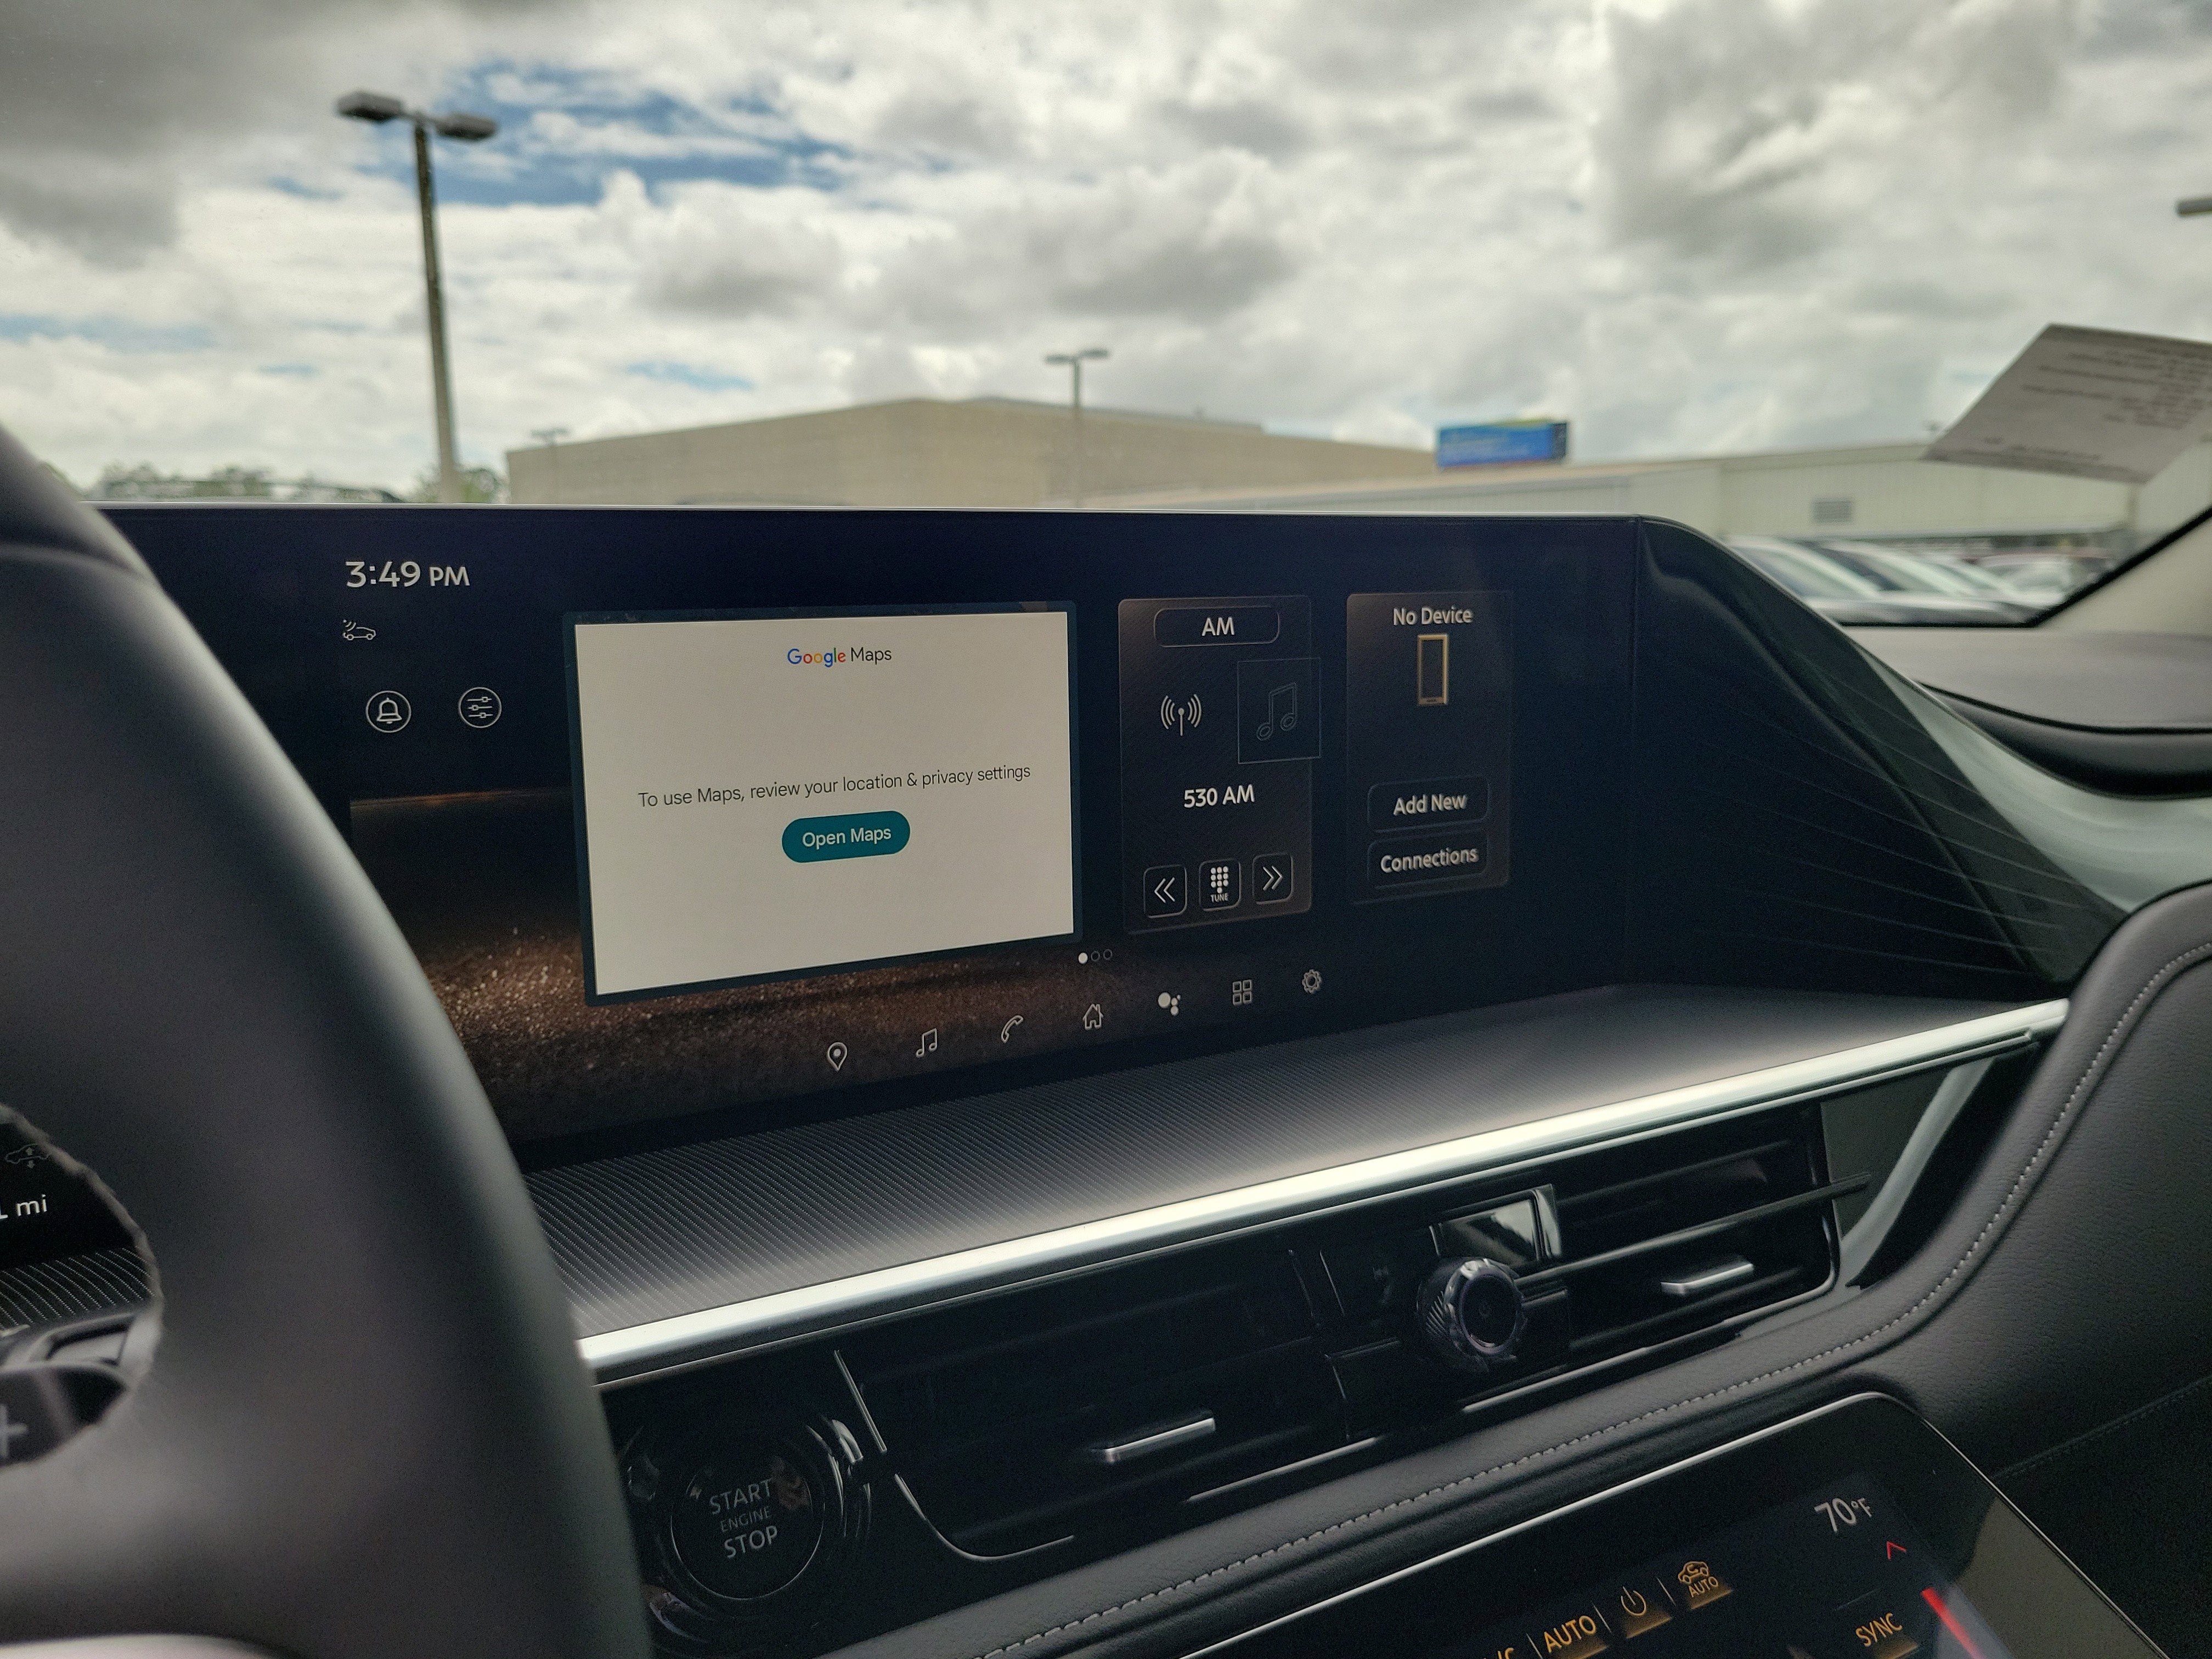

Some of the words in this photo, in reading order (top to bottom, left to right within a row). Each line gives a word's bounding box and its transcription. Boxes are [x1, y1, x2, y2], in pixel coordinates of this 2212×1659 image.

[345, 561, 421, 588] 3:49
[430, 566, 470, 586] PM
[1201, 617, 1235, 636] AM
[1393, 608, 1417, 625] No
[1421, 606, 1473, 624] Device
[787, 647, 846, 668] Google
[850, 646, 892, 665] Maps
[638, 792, 658, 807] To
[664, 792, 692, 806] use
[697, 787, 745, 805] Maps,
[751, 781, 800, 799] review
[804, 780, 838, 798] your
[843, 773, 902, 791] location
[907, 772, 918, 787] &
[922, 769, 973, 789] privacy
[978, 764, 1031, 782] settings
[1184, 788, 1217, 808] 530
[1222, 785, 1255, 805] AM
[1393, 794, 1427, 815] Add
[1431, 794, 1468, 811] New
[802, 831, 846, 850] Open
[850, 826, 891, 845] Maps
[1380, 848, 1479, 873] Connections
[1210, 893, 1228, 902] TUNE
[15, 1194, 47, 1216] mi
[709, 1479, 771, 1514] START
[720, 1506, 772, 1532] ENGINE
[724, 1525, 778, 1559] STOP
[1689, 1576, 1719, 1598] AUTO
[1543, 1615, 1596, 1653] AUTO
[1855, 1612, 1903, 1646] SYNC
